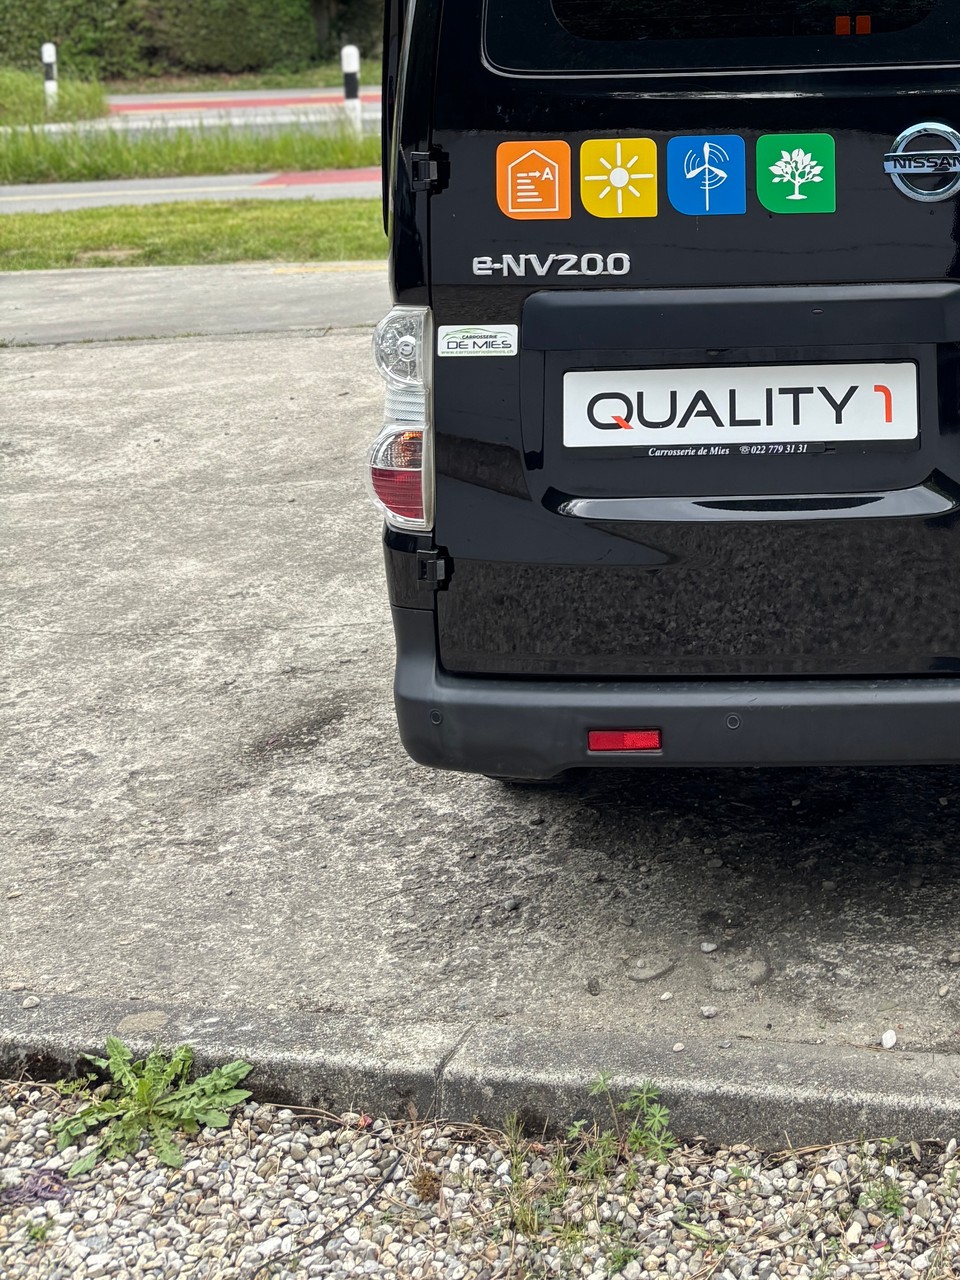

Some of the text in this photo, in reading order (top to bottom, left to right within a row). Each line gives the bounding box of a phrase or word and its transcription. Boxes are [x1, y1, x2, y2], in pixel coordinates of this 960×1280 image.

[541, 167, 554, 181] A
[472, 252, 631, 277] e-NV200
[447, 340, 512, 350] DE MIES
[586, 384, 893, 430] QUALITY 1
[648, 444, 808, 457] Carrosserie de Mies 022 779 31 31
